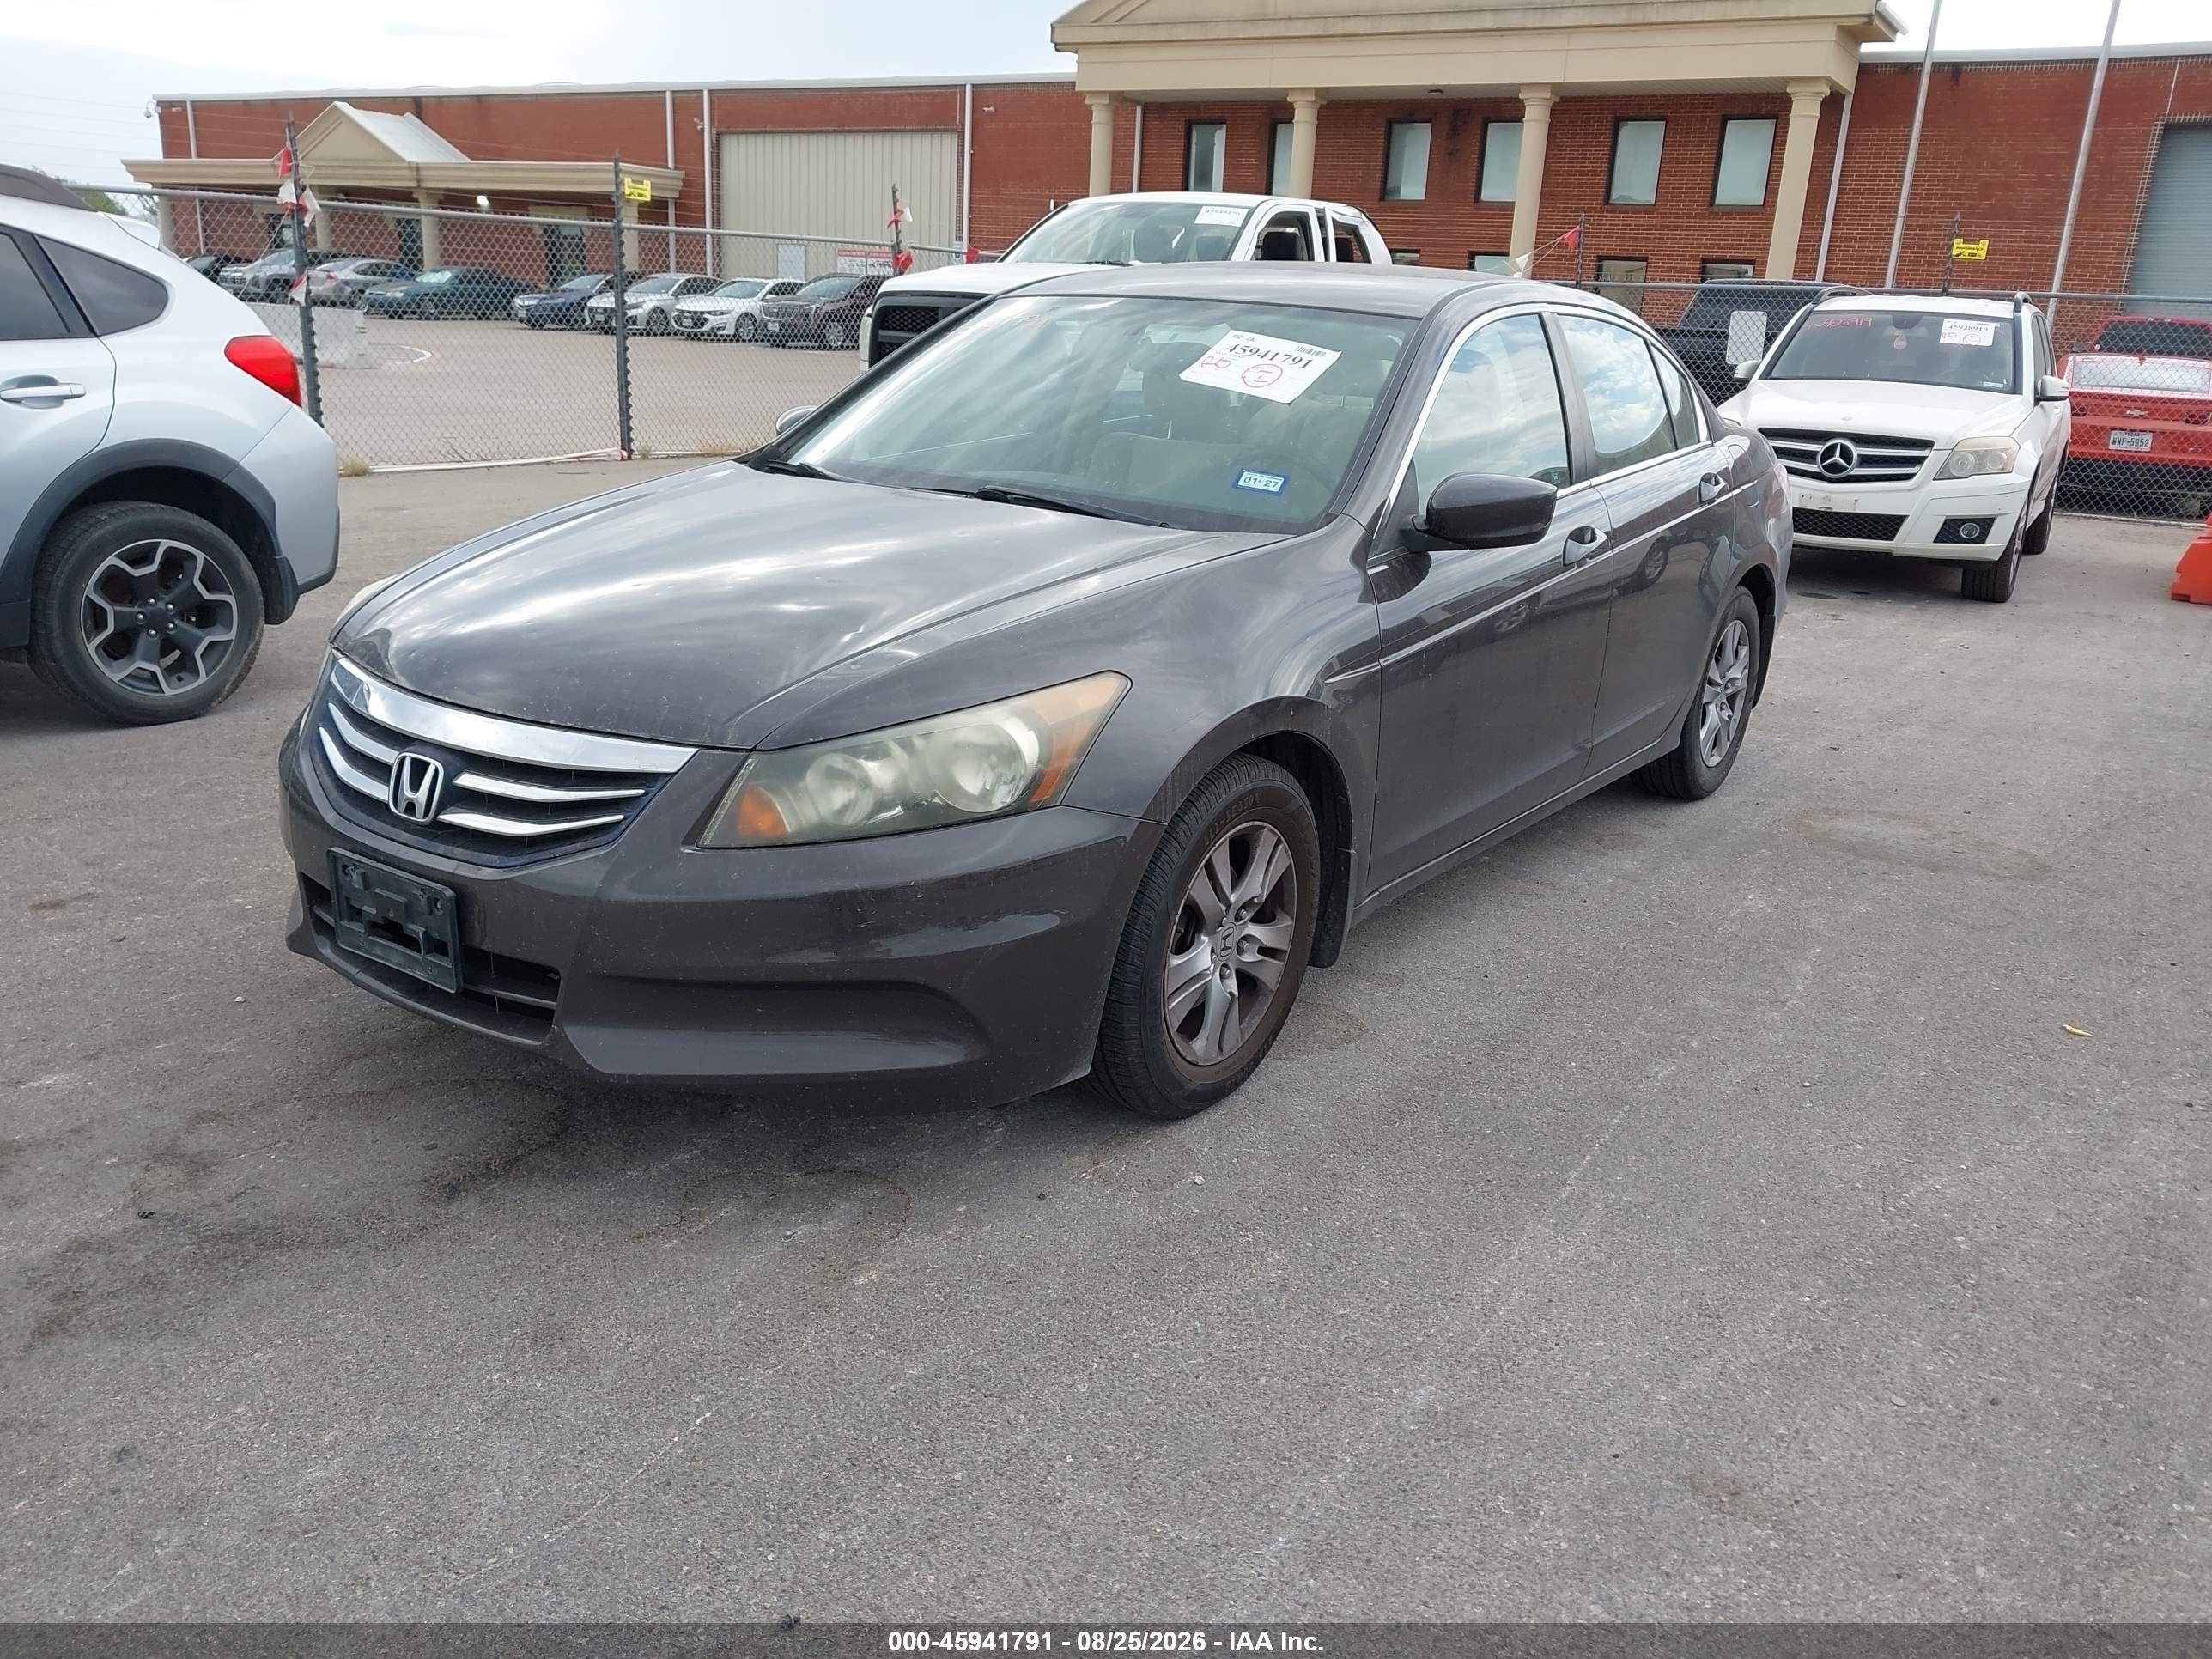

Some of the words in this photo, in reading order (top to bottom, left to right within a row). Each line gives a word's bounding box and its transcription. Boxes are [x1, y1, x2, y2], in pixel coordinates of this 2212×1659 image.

[1225, 343, 1313, 368] 45941791
[1243, 476, 1258, 485] 01
[1263, 479, 1280, 489] 27
